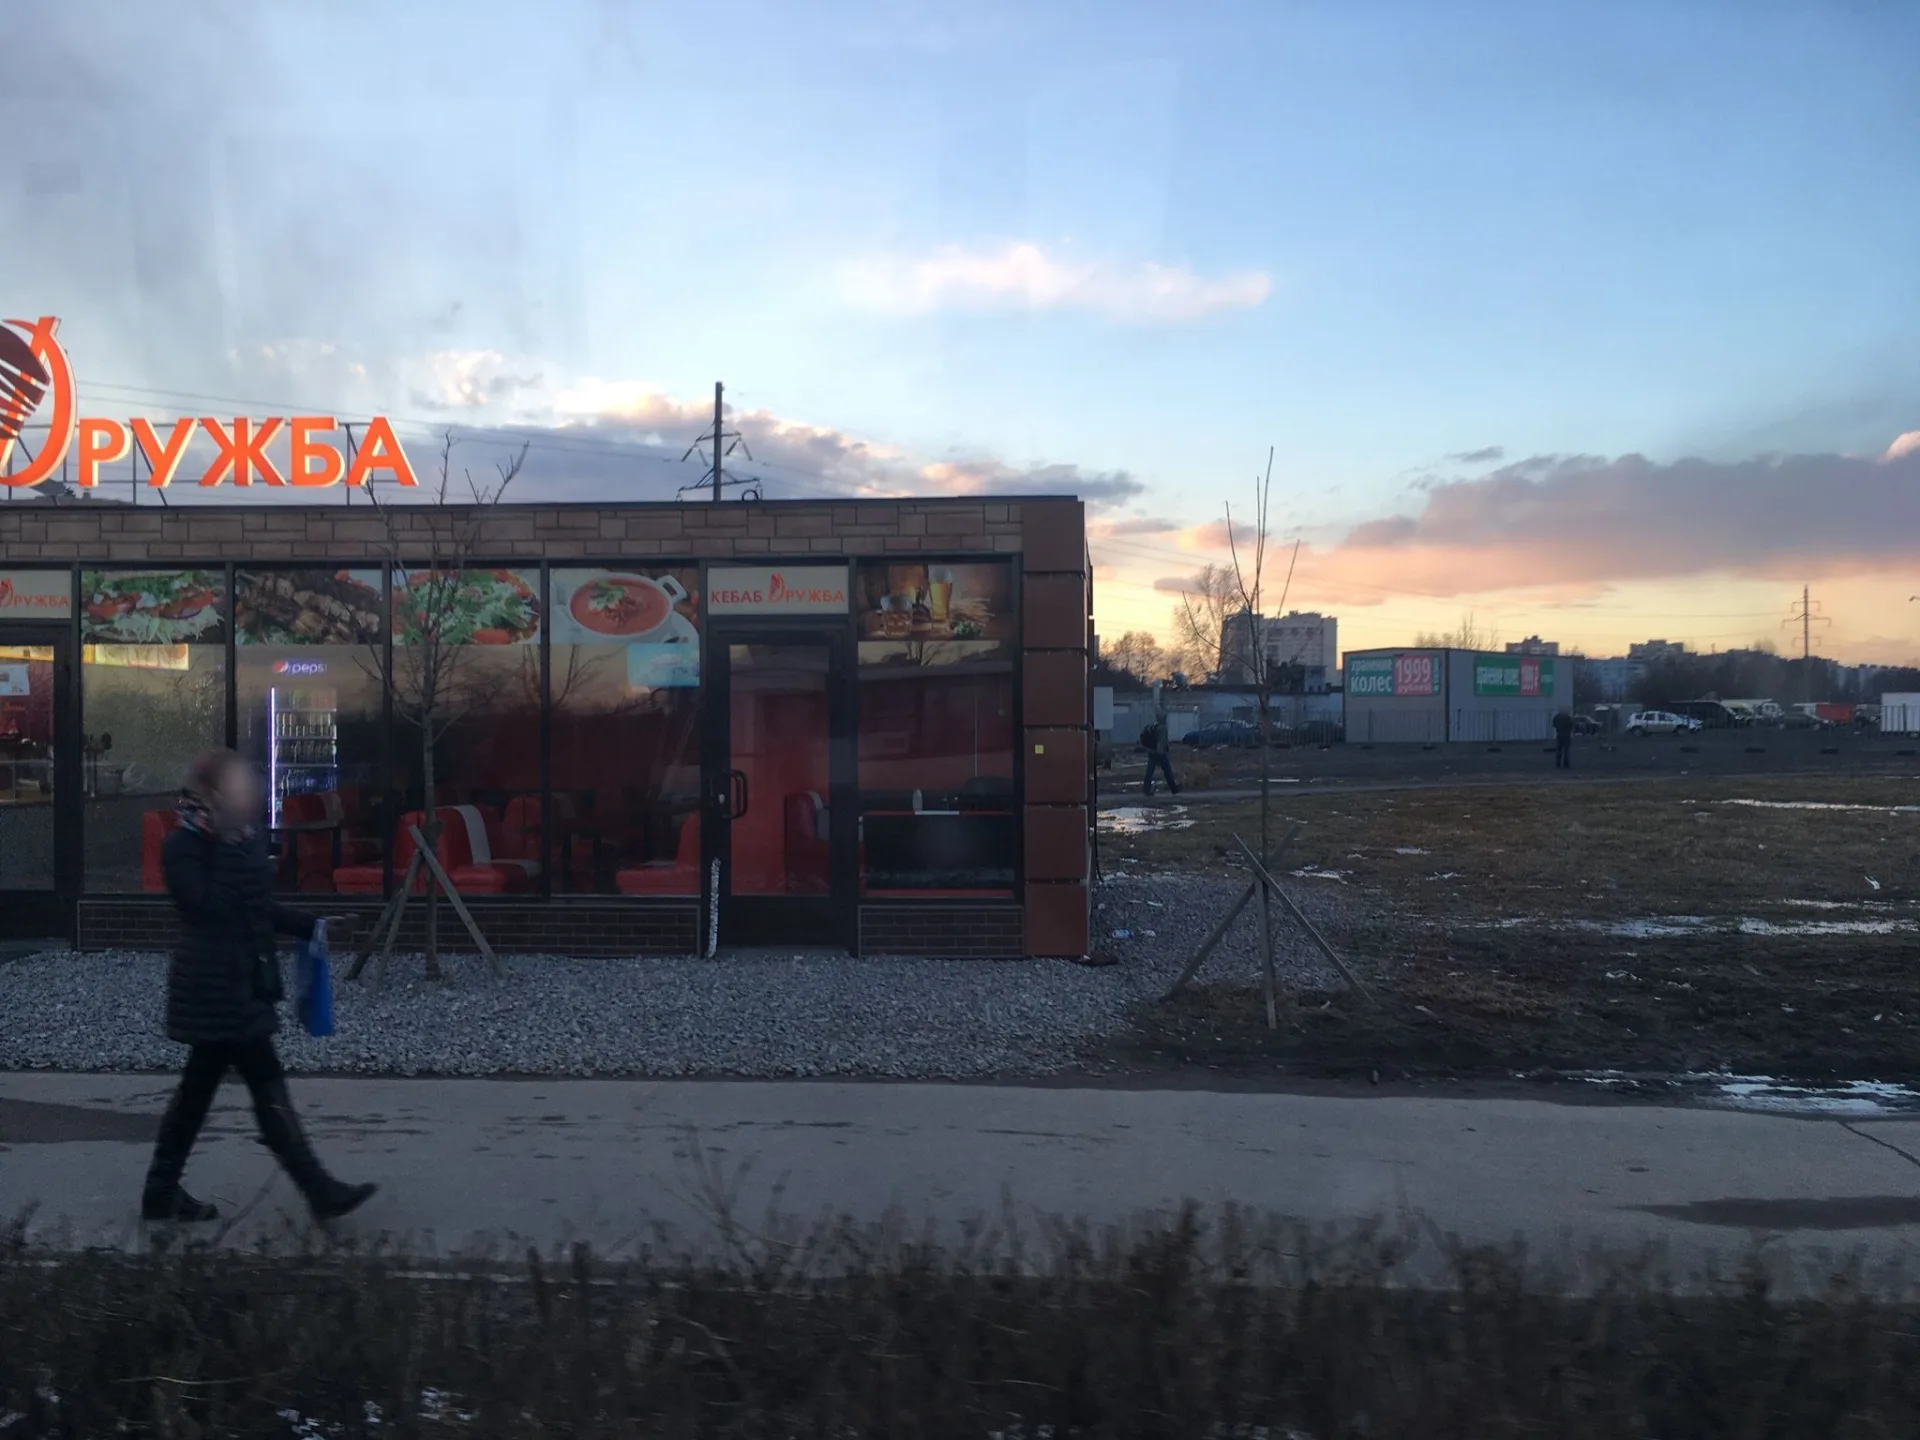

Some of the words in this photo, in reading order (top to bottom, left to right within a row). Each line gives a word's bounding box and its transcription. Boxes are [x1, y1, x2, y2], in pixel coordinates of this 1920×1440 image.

[711, 589, 762, 604] КЕБАБ
[1395, 658, 1432, 684] 1999
[1350, 675, 1393, 693] колес
